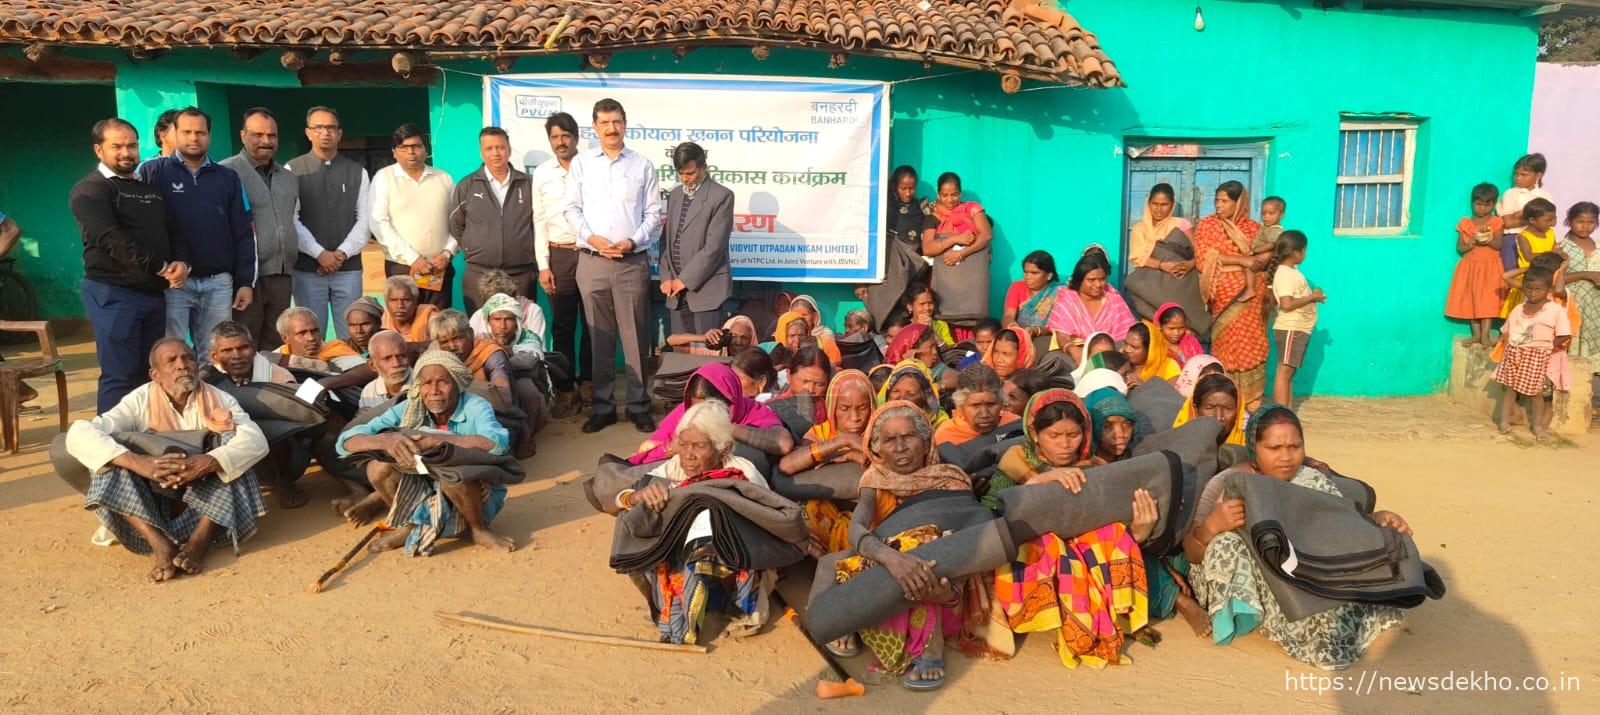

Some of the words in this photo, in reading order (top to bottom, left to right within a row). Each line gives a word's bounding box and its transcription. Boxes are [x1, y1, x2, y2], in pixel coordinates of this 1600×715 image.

[810, 97, 858, 113] बनहरदी
[687, 128, 734, 142] खनन
[739, 125, 819, 144] परियोजना
[772, 167, 847, 187] कार्यक्रम
[730, 243, 757, 252] VIDYUT
[760, 244, 795, 253] UTPADAN
[798, 244, 823, 253] NIGAM
